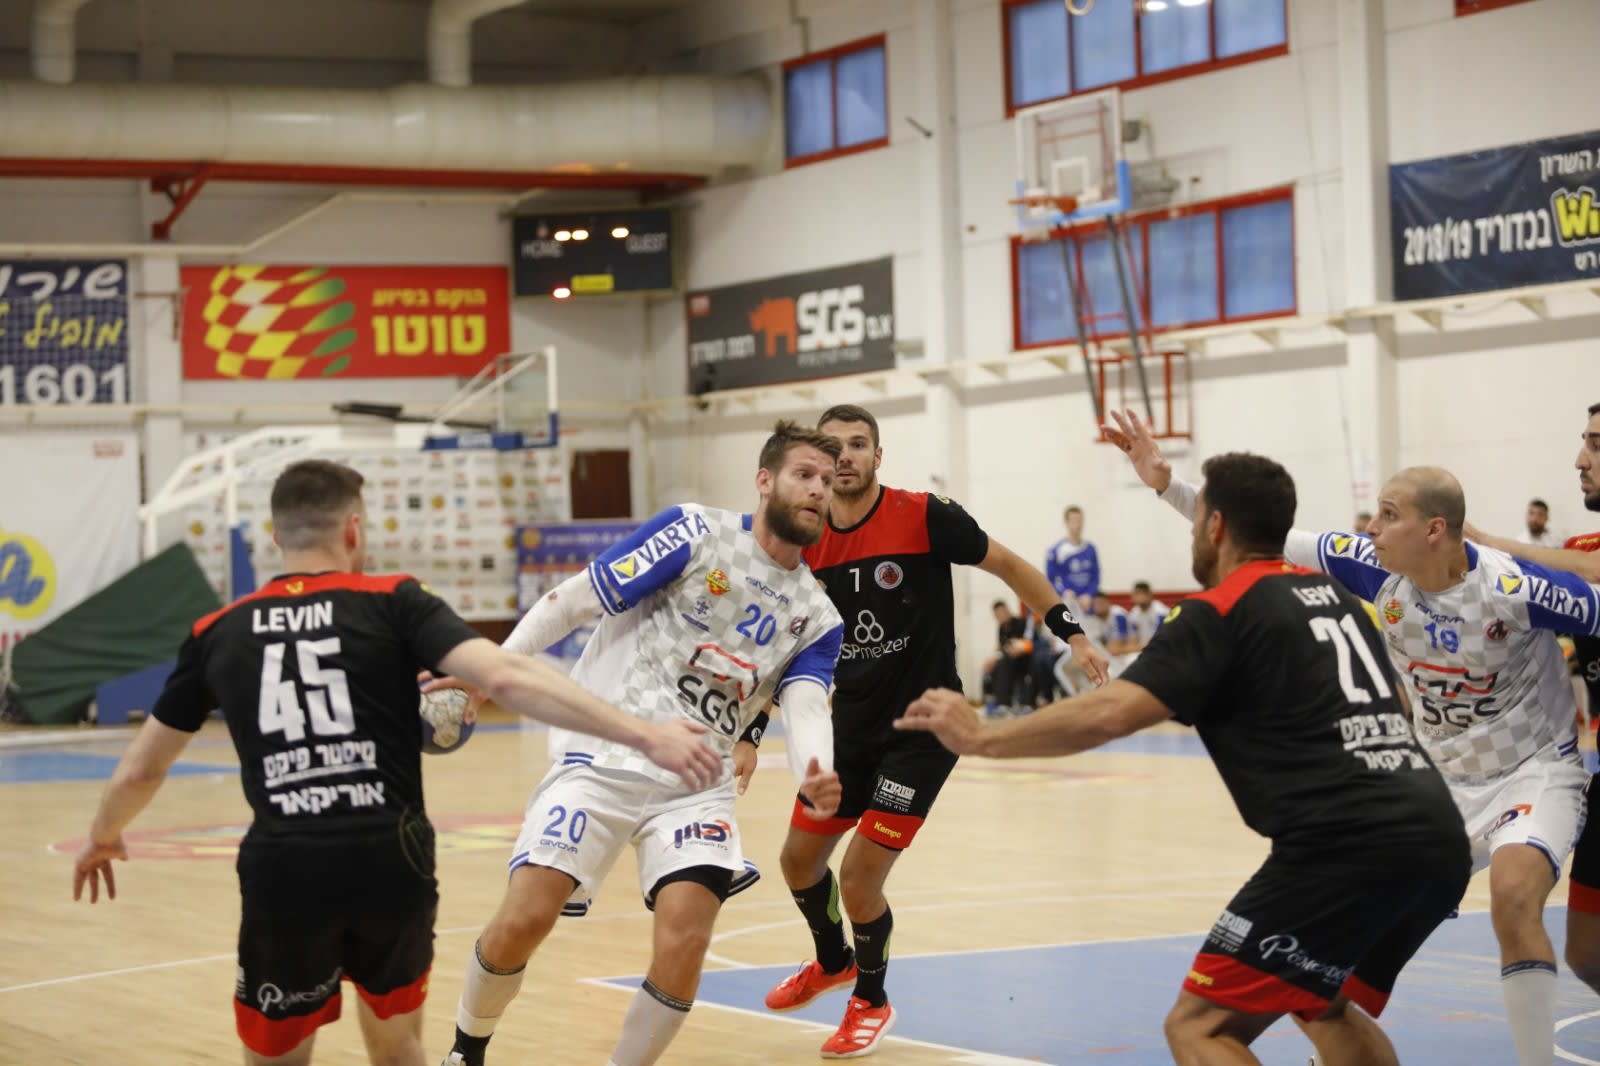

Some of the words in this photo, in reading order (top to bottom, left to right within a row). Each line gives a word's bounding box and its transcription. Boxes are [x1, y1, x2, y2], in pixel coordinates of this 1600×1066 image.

[1404, 216, 1473, 265] 2018/19
[373, 315, 486, 355] טוטו
[797, 284, 864, 352] SGS
[638, 512, 712, 566] VARTA
[252, 600, 333, 634] LEVIN
[736, 603, 777, 647] 20
[1423, 621, 1460, 654] 19
[258, 636, 356, 743] 45
[677, 674, 740, 736] SGS
[269, 781, 387, 815] אוריקאר
[542, 804, 588, 844] 20
